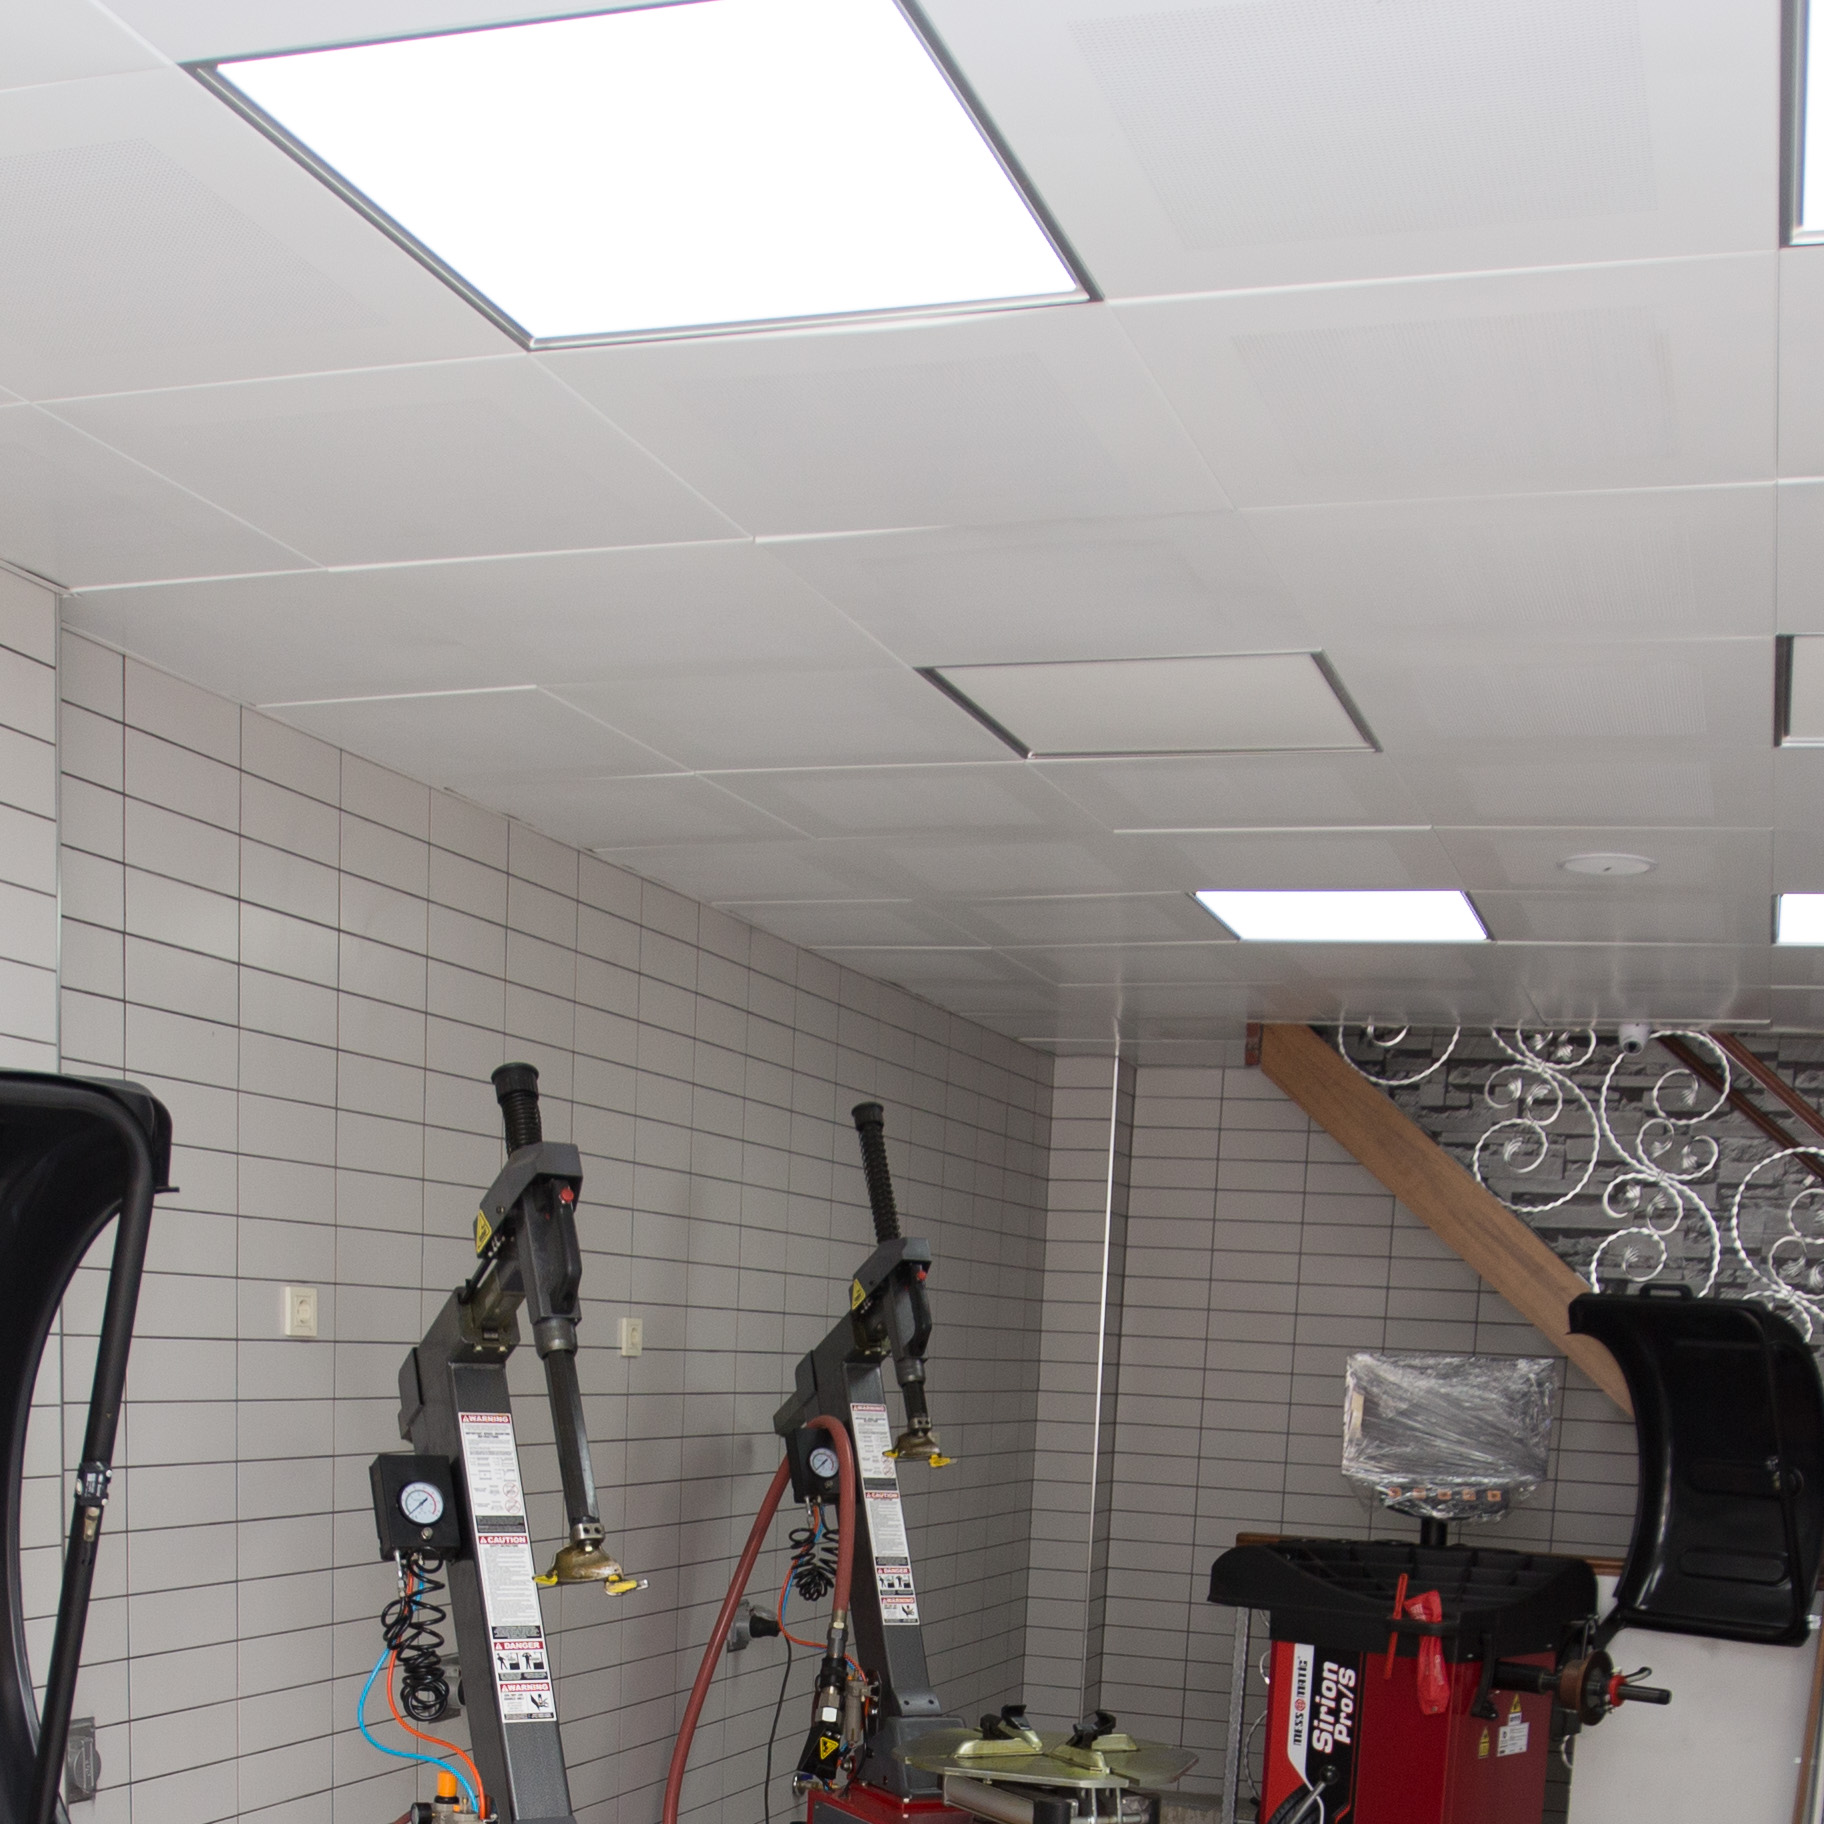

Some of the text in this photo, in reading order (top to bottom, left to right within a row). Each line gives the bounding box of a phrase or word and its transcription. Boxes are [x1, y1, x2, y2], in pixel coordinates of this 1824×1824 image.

[487, 1536, 526, 1544] CAUTION
[504, 1642, 541, 1650] DANGER
[507, 1683, 549, 1691] WARNING
[1312, 1661, 1339, 1754] Sirion
